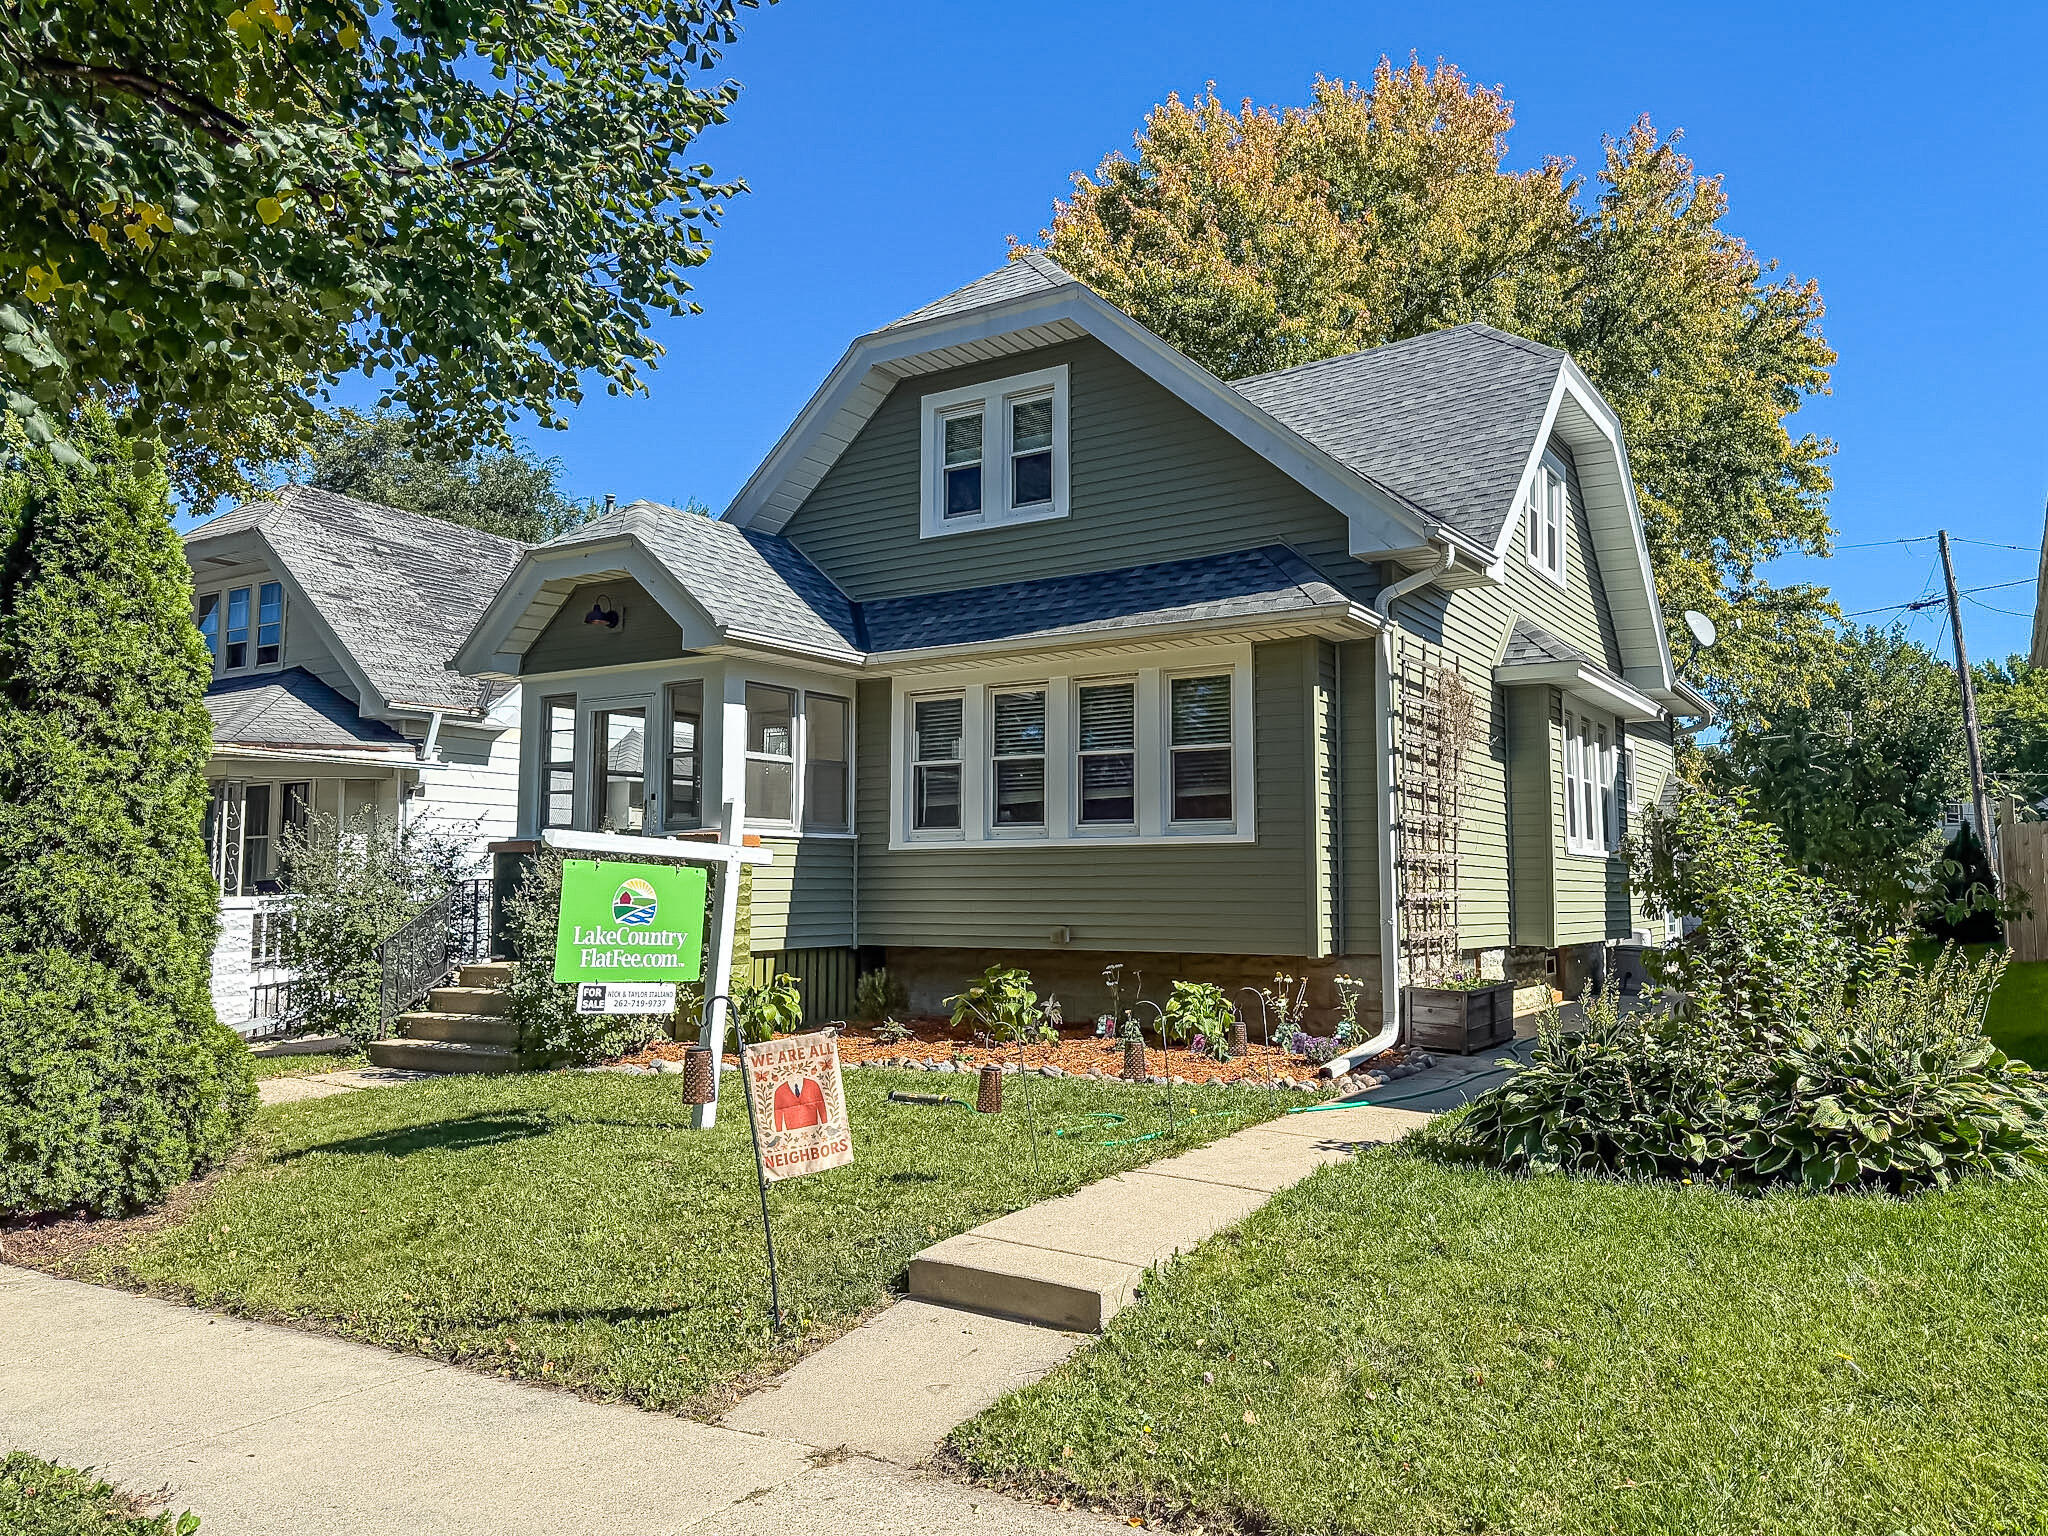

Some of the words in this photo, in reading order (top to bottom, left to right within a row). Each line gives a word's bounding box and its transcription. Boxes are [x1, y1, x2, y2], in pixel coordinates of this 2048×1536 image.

[573, 925, 688, 950] LakeCountry
[579, 948, 678, 968] FlatFee.com
[583, 987, 603, 998] FOR
[581, 1000, 606, 1009] SALE
[751, 1052, 775, 1068] WE
[777, 1047, 806, 1064] ARE
[809, 1042, 834, 1057] ALL
[763, 1138, 849, 1169] NEIGHBORS
